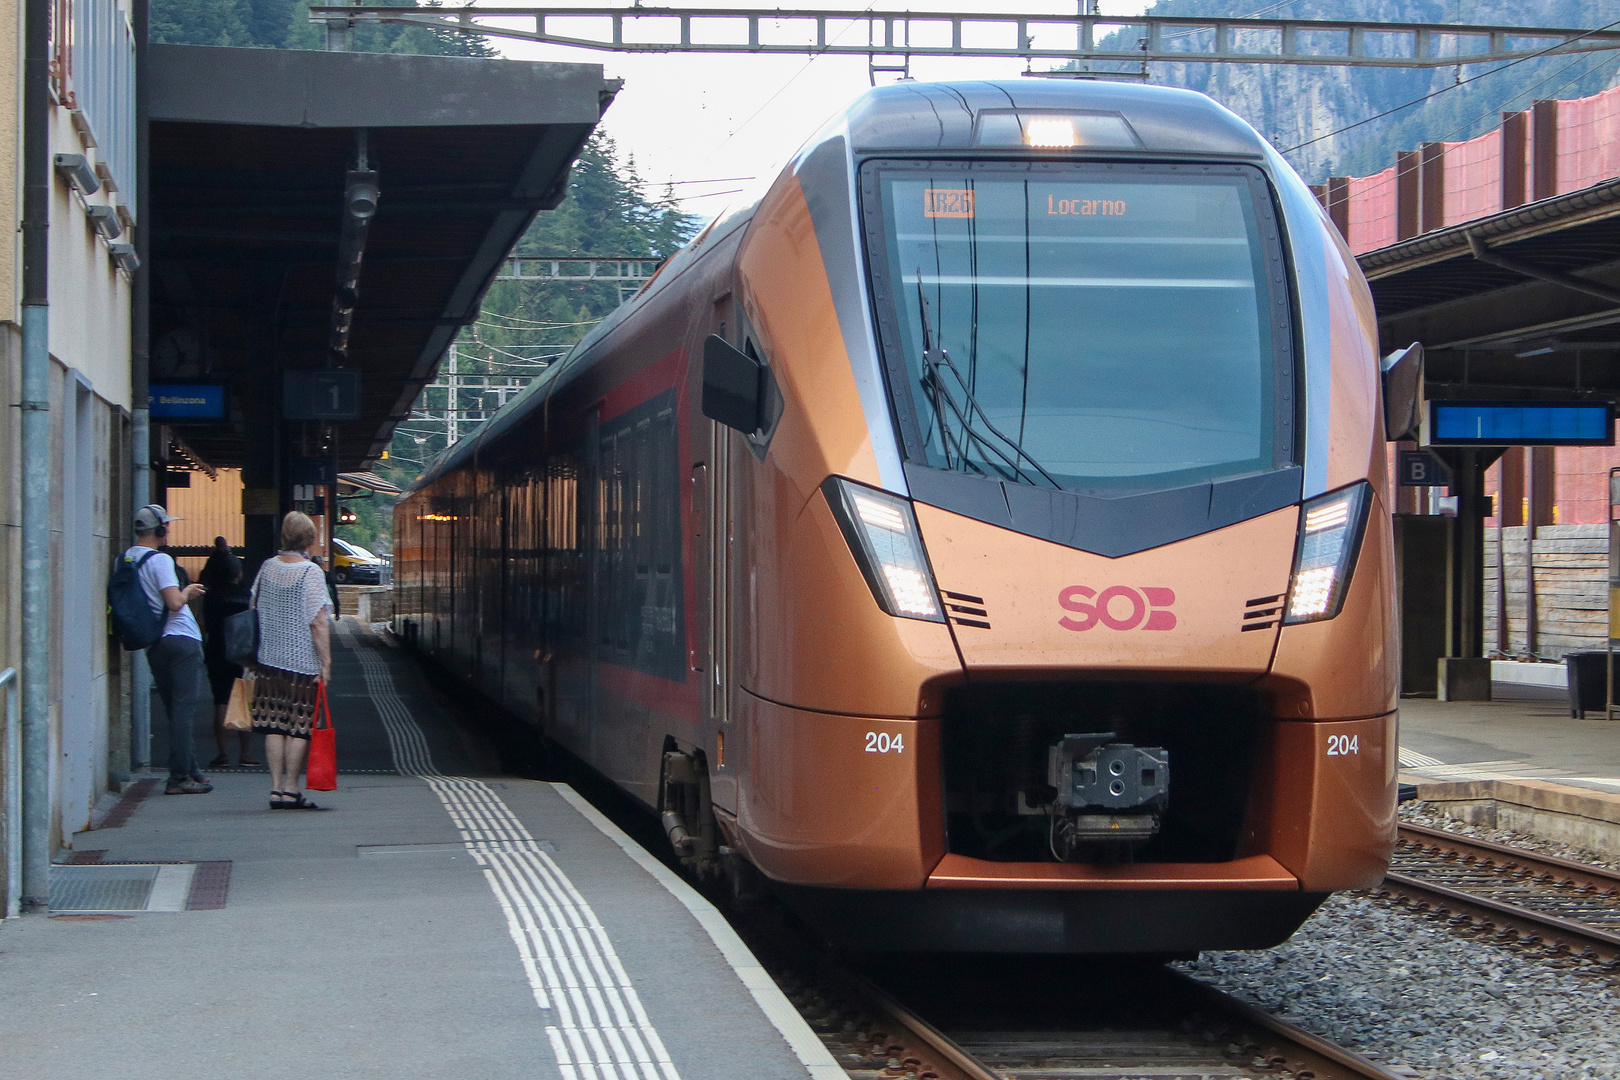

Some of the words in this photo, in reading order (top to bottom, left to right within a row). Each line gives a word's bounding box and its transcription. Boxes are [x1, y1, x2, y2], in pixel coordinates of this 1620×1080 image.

[926, 191, 973, 214] IR26
[1048, 194, 1126, 215] Locarno
[159, 396, 207, 405] Bellinzona
[329, 384, 340, 410] 1
[1411, 462, 1426, 480] B
[1058, 585, 1177, 632] SOB
[865, 731, 904, 754] 204
[1327, 734, 1359, 756] 204
